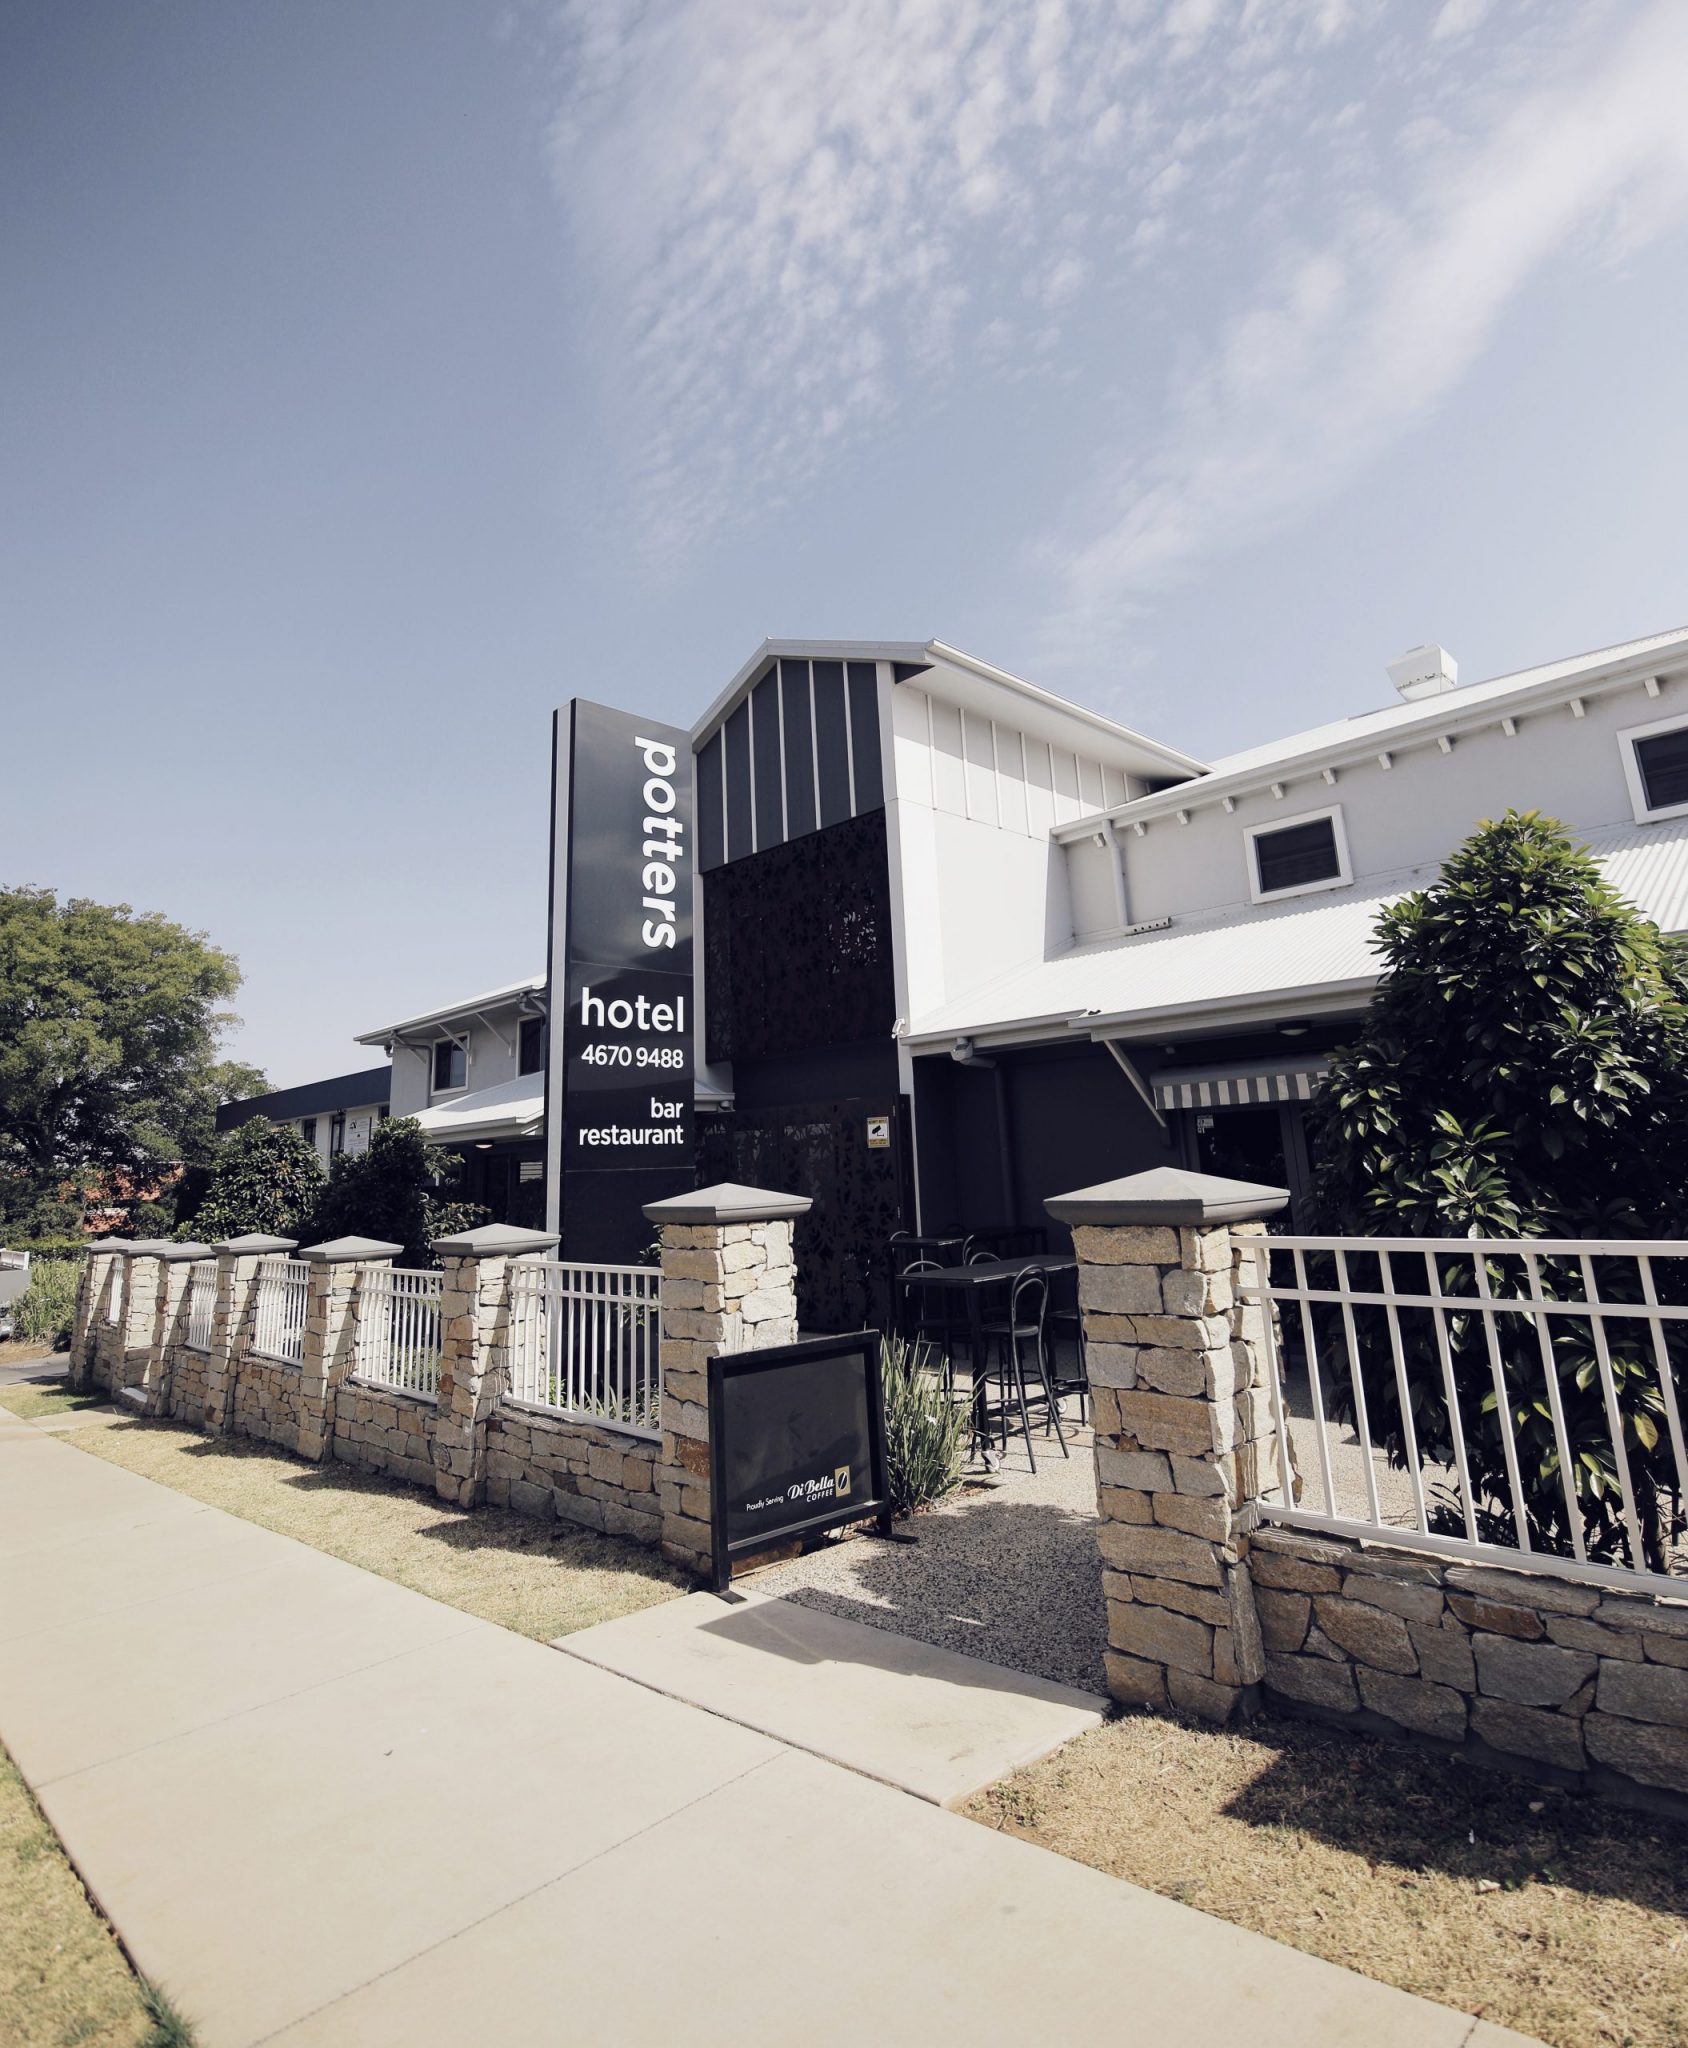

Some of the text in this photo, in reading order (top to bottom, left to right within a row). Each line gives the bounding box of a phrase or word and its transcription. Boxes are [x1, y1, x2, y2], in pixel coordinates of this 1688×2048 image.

[634, 735, 683, 949] potters
[581, 986, 684, 1033] hotel
[581, 1044, 684, 1069] 4670 9488
[650, 1097, 684, 1119] bar
[579, 1124, 684, 1146] restaurant
[746, 1475, 835, 1512] Proudly Serving Di Bella
[806, 1488, 834, 1503] COFFEE
